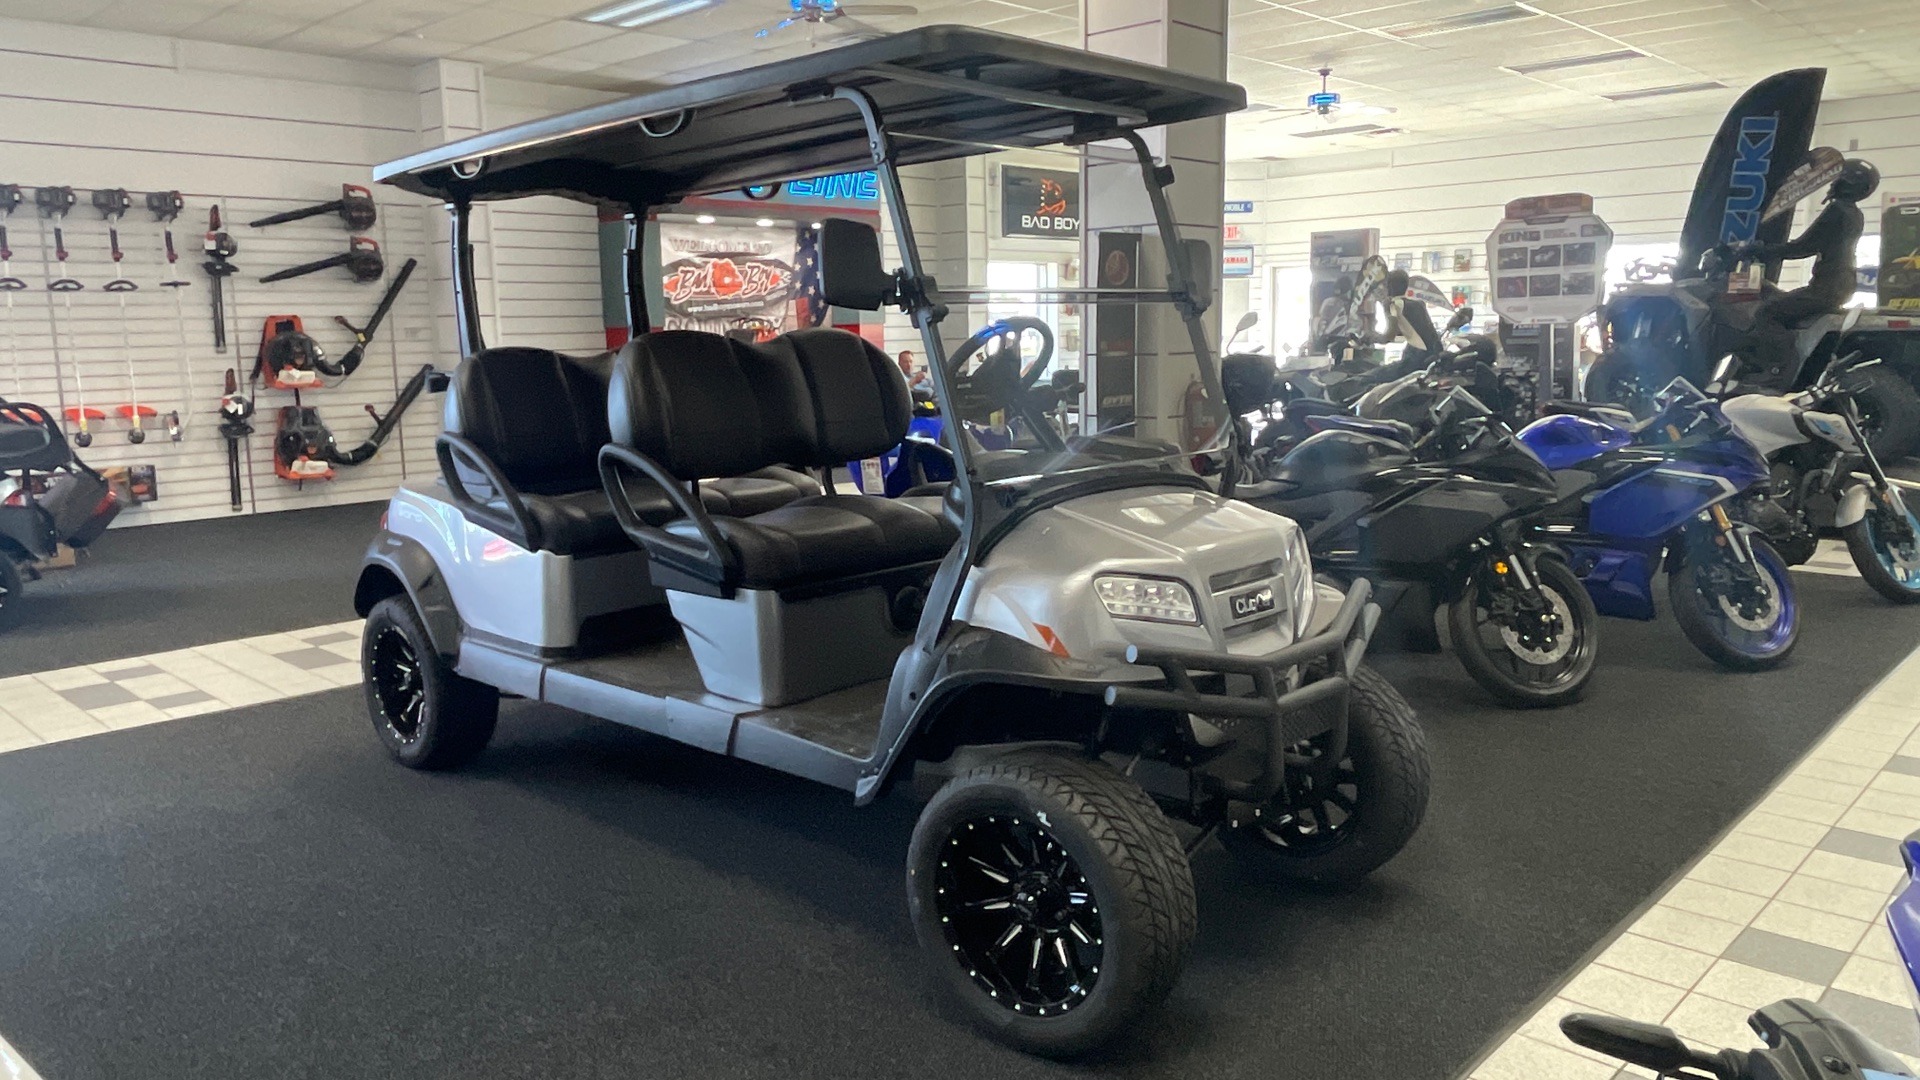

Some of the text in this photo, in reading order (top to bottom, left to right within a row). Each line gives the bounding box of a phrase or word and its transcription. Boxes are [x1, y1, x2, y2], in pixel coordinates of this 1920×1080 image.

[1022, 214, 1080, 230] BAD BOY
[669, 238, 751, 253] WELCOME
